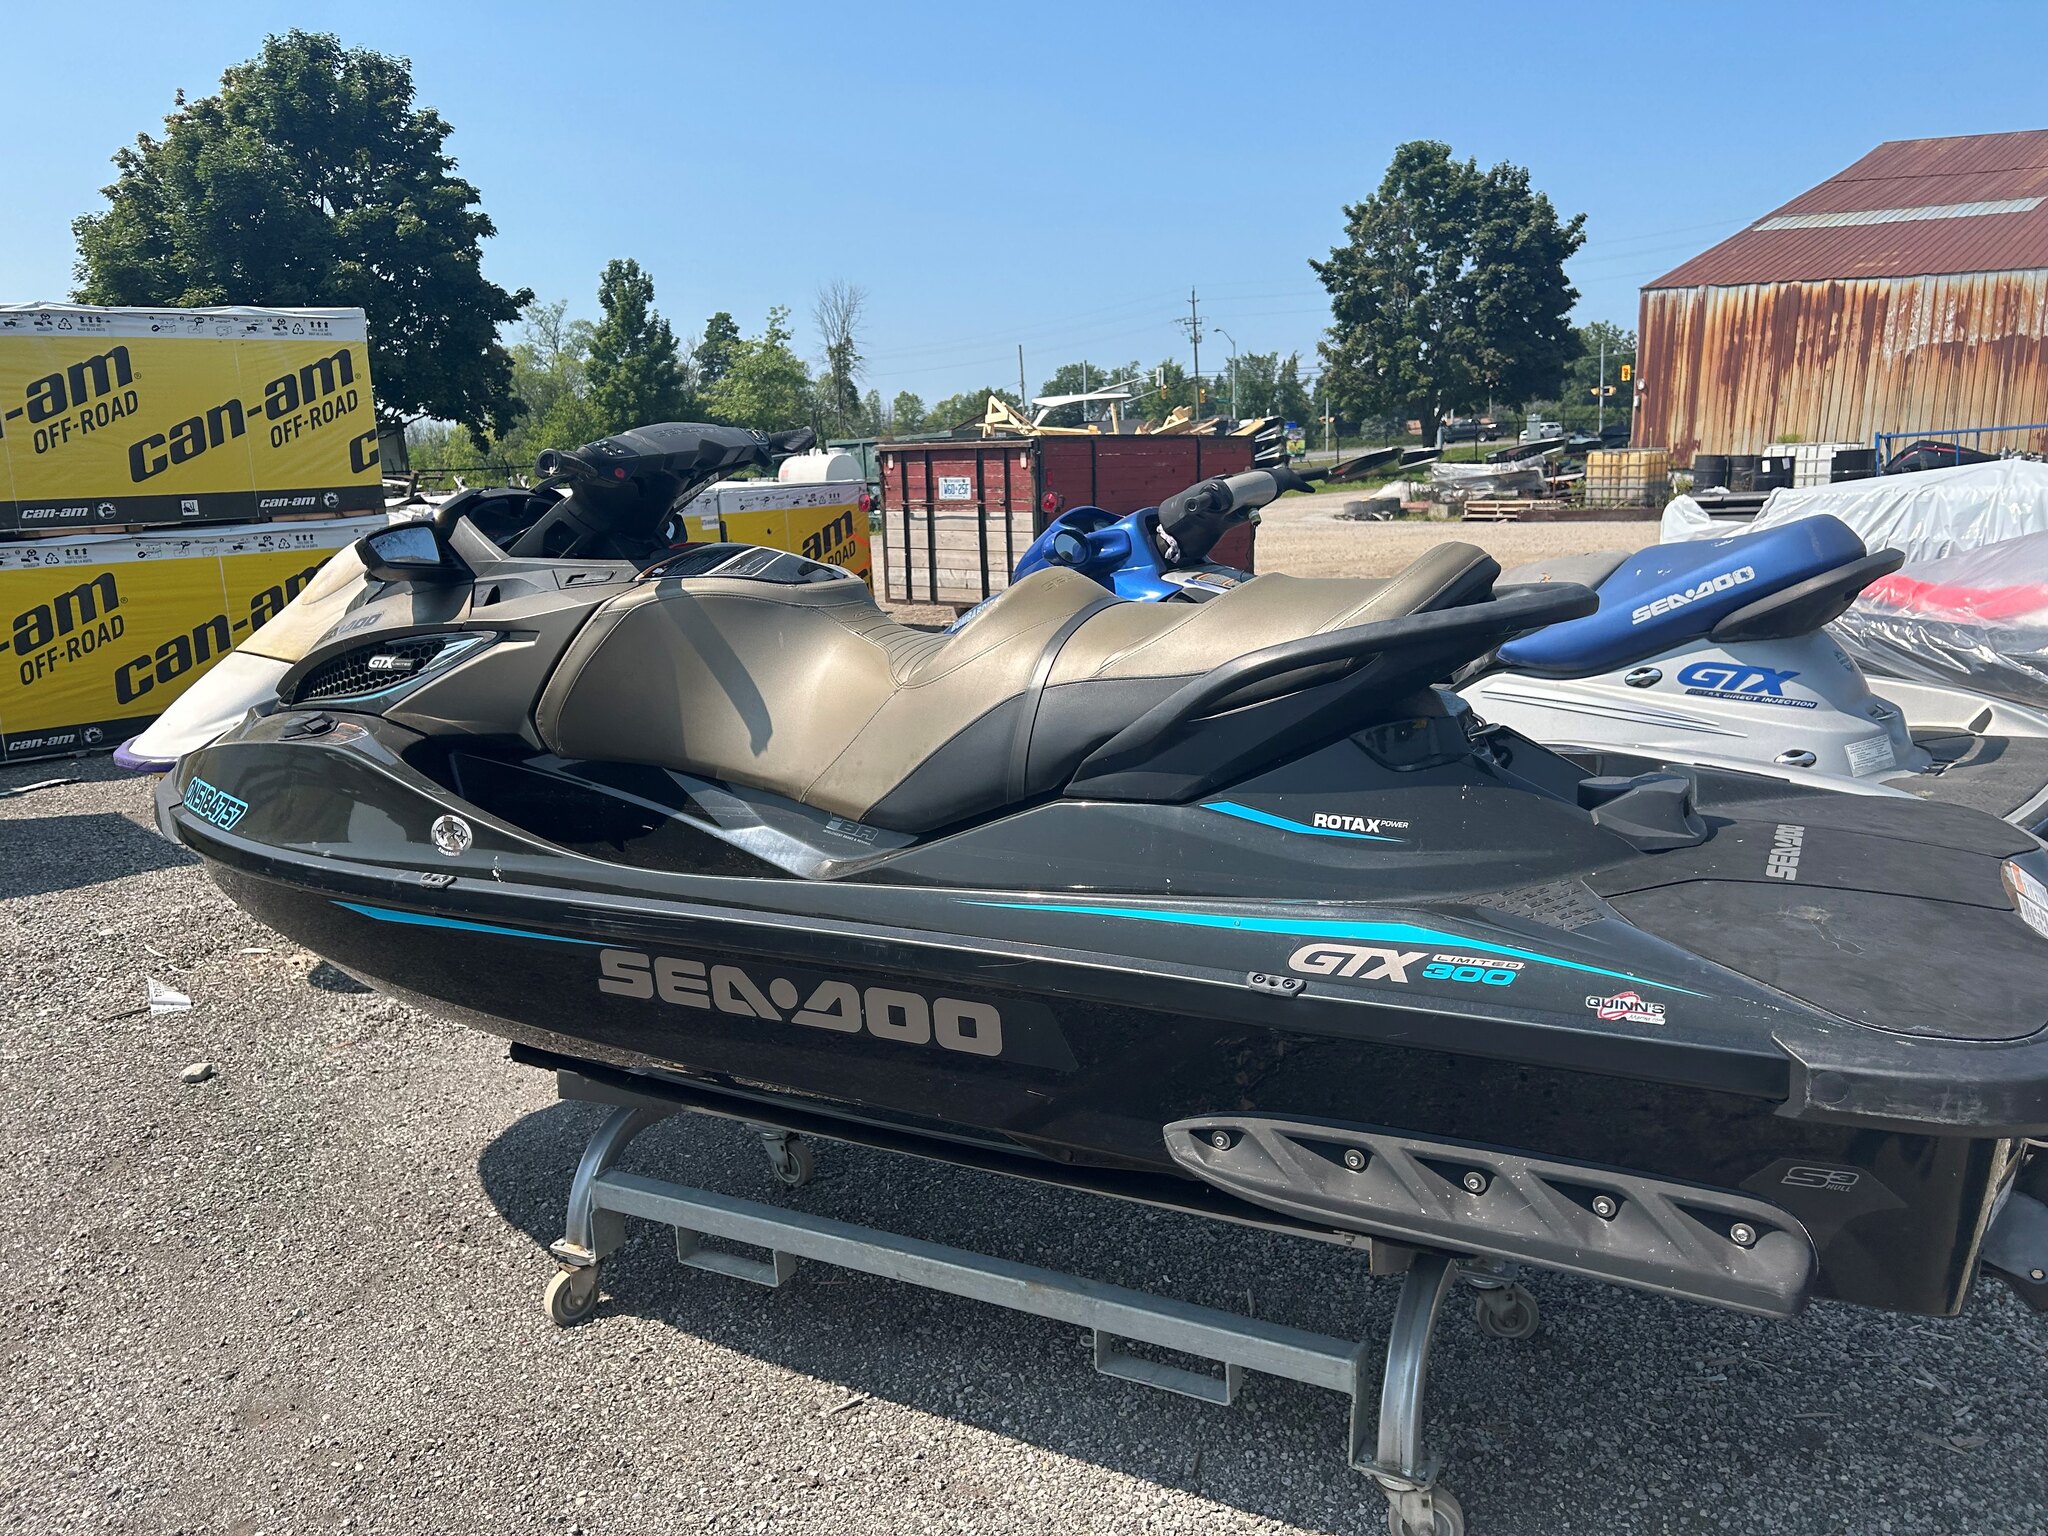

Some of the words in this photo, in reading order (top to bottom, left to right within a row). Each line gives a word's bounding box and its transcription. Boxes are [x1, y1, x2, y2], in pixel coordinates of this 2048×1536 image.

[33, 390, 138, 454] OFF-ROAD
[128, 349, 354, 483] can-am
[271, 389, 358, 449] OFF-ROAD
[260, 495, 316, 508] can-am
[22, 506, 88, 519] can-am
[20, 614, 125, 686] OFF-ROAD
[369, 656, 396, 669] GTX
[1677, 661, 1800, 696] GTX
[1723, 692, 1758, 702] DIRECT
[1761, 696, 1815, 708] INJECTION
[9, 734, 75, 751] can-am
[1313, 813, 1381, 833] ROTAX
[1380, 820, 1409, 829] POWER
[1288, 943, 1430, 983] GTX
[1435, 955, 1520, 969] LIMITED
[1422, 963, 1517, 986] 300
[1587, 997, 1665, 1014] QUINN'S
